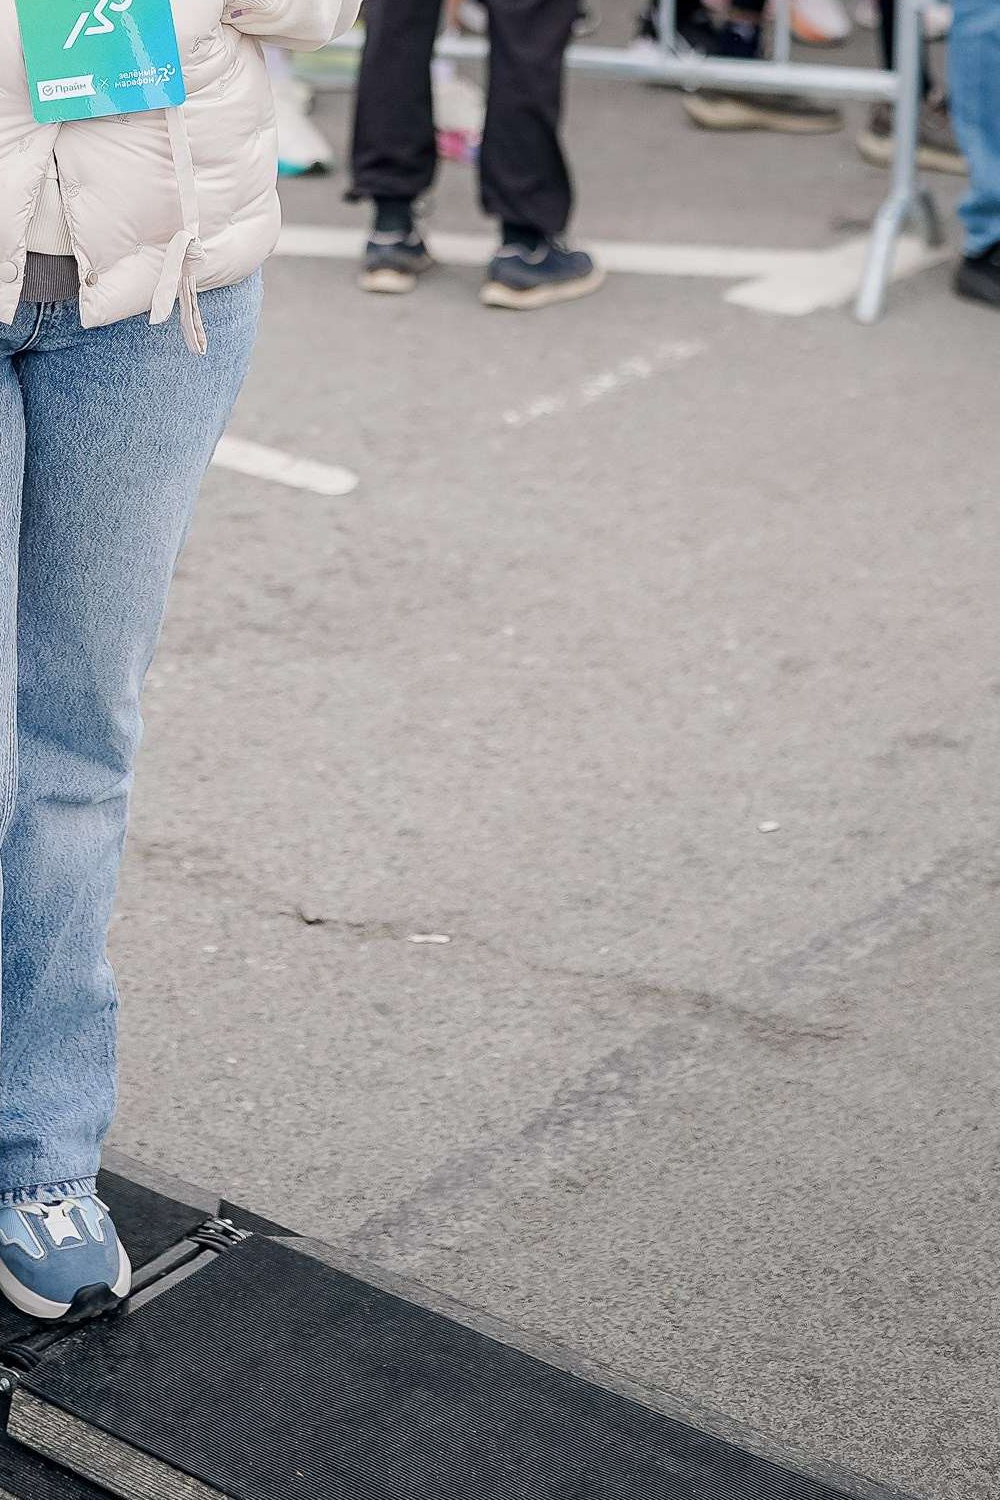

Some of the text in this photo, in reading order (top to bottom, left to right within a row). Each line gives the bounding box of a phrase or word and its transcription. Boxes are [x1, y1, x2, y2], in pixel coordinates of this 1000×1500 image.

[118, 67, 157, 80] зелёный
[55, 82, 87, 94] Прайм
[114, 77, 155, 89] марафон
